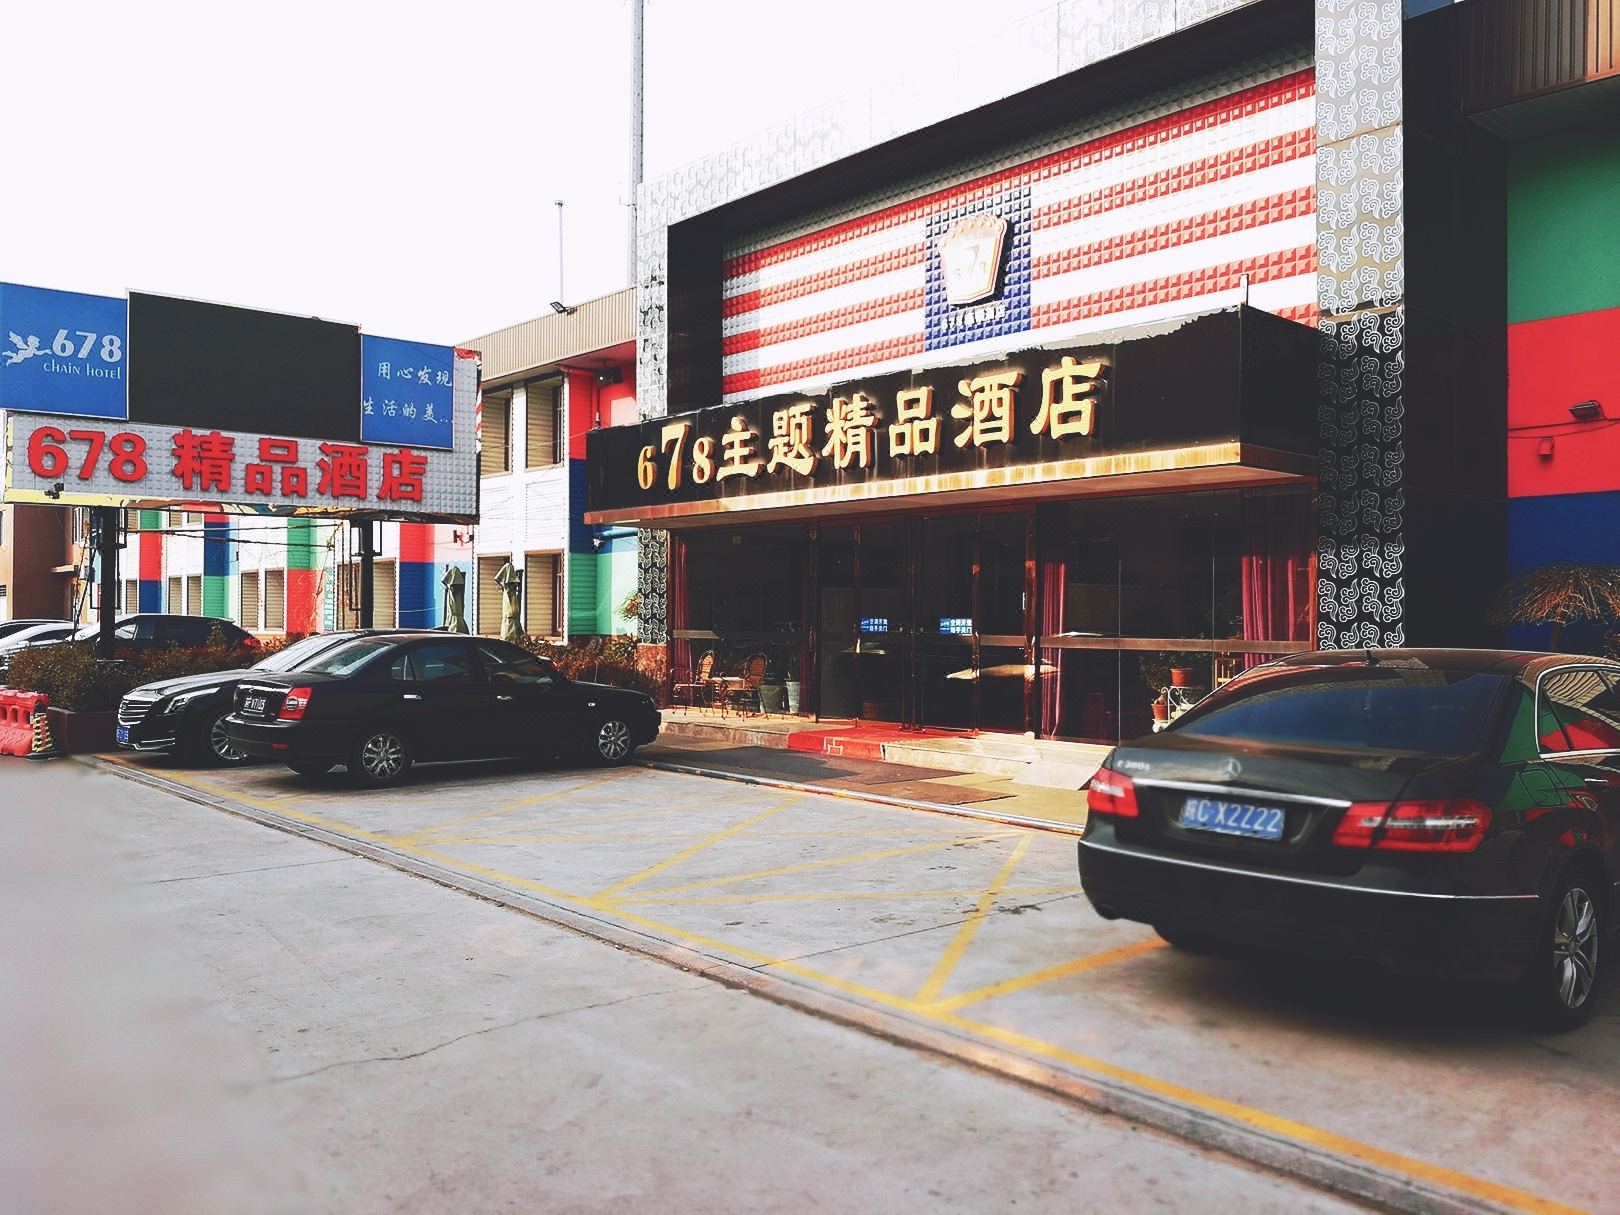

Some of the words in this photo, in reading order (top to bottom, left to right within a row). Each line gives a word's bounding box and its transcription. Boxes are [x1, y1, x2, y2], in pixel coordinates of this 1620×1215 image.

[52, 328, 122, 363] 678
[377, 361, 453, 387] 用心发现
